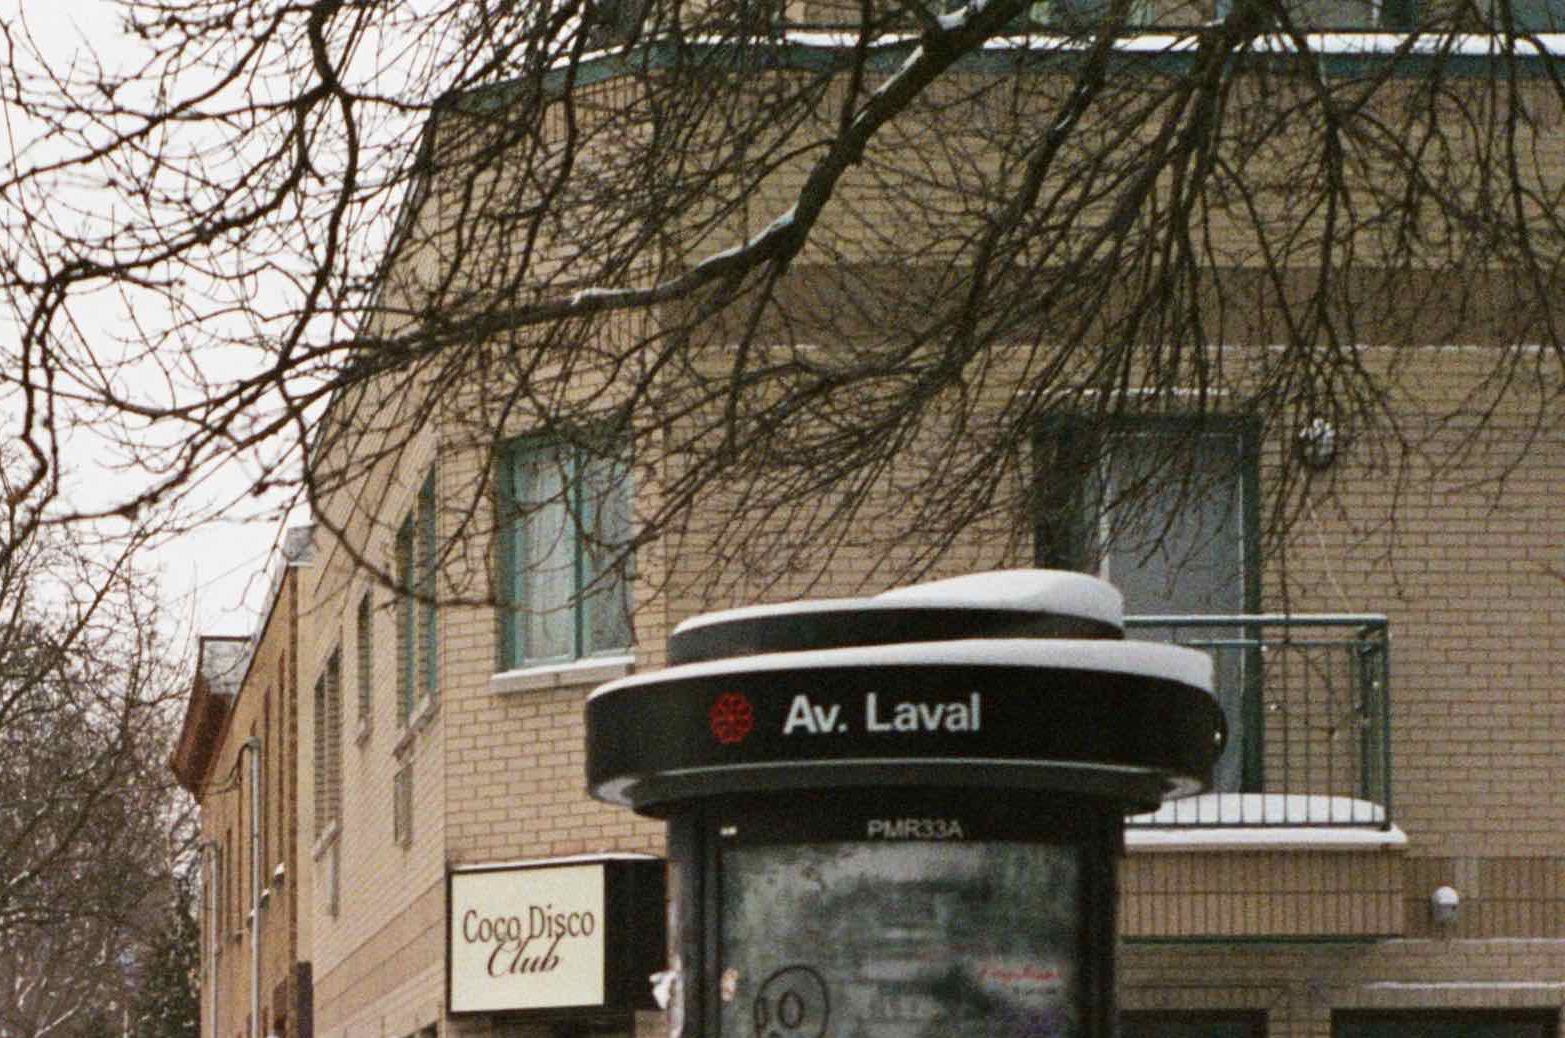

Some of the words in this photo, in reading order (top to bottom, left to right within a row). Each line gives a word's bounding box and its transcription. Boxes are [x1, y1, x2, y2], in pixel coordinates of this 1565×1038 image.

[783, 694, 848, 734] Av.
[866, 692, 981, 732] Laval
[866, 819, 964, 839] PMR33A
[462, 909, 522, 944] Coco
[529, 903, 596, 940] Disco
[487, 933, 561, 978] Club
